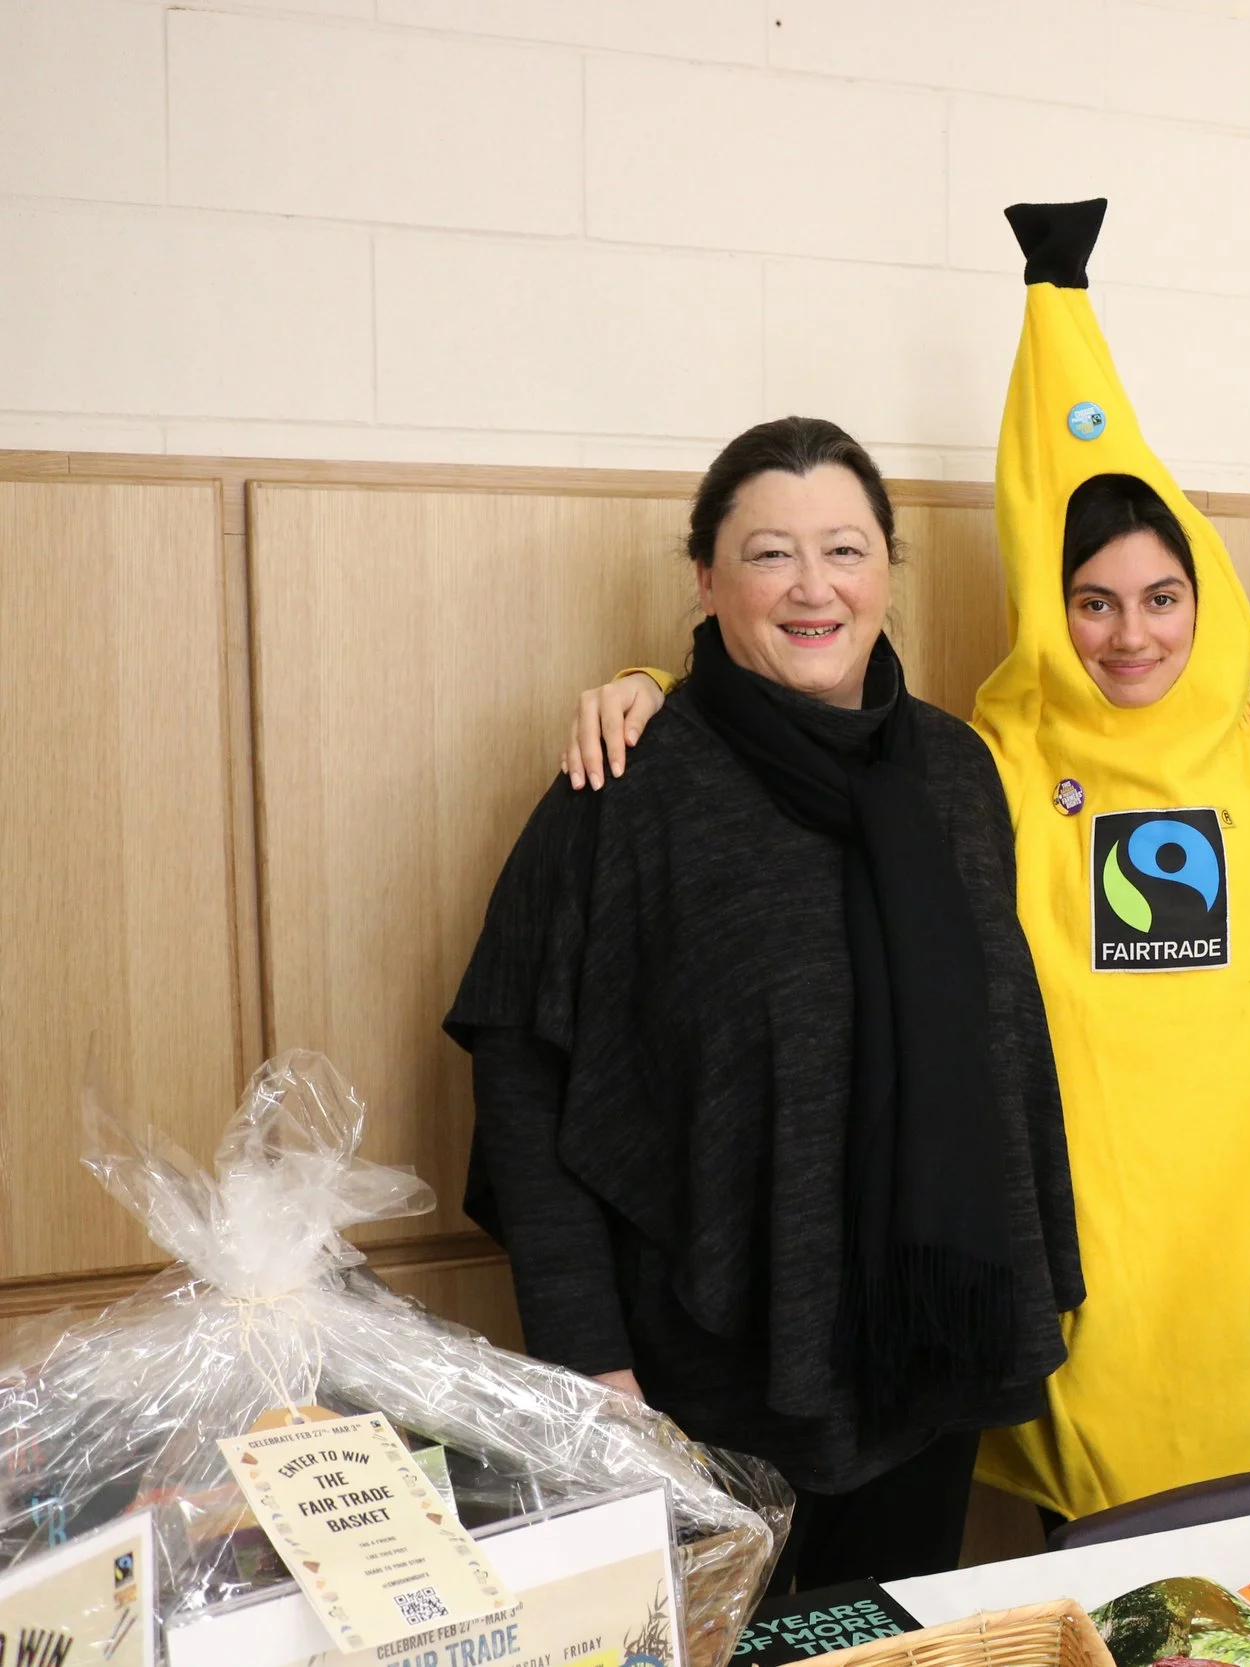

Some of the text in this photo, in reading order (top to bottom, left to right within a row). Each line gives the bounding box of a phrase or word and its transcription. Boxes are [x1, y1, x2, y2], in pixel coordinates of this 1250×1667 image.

[1102, 938, 1222, 961] FAIRTRADE
[248, 1434, 295, 1449] CELEBRATE
[296, 1432, 312, 1442] FEB
[331, 1426, 350, 1435] MAR
[278, 1450, 370, 1480] ENTER TO WIN
[313, 1471, 349, 1490] THE
[298, 1485, 395, 1518] FAIR TRADE
[326, 1508, 392, 1534] BASKET
[756, 1599, 879, 1633] YEARS
[16, 1627, 74, 1667] WIN
[376, 1629, 435, 1660] CELEBRATE
[437, 1623, 457, 1641] FEB
[445, 1623, 521, 1667] TRADE
[563, 1636, 602, 1660] FRIDAY
[733, 1611, 894, 1656] OF MORE
[794, 1623, 905, 1656] THAN
